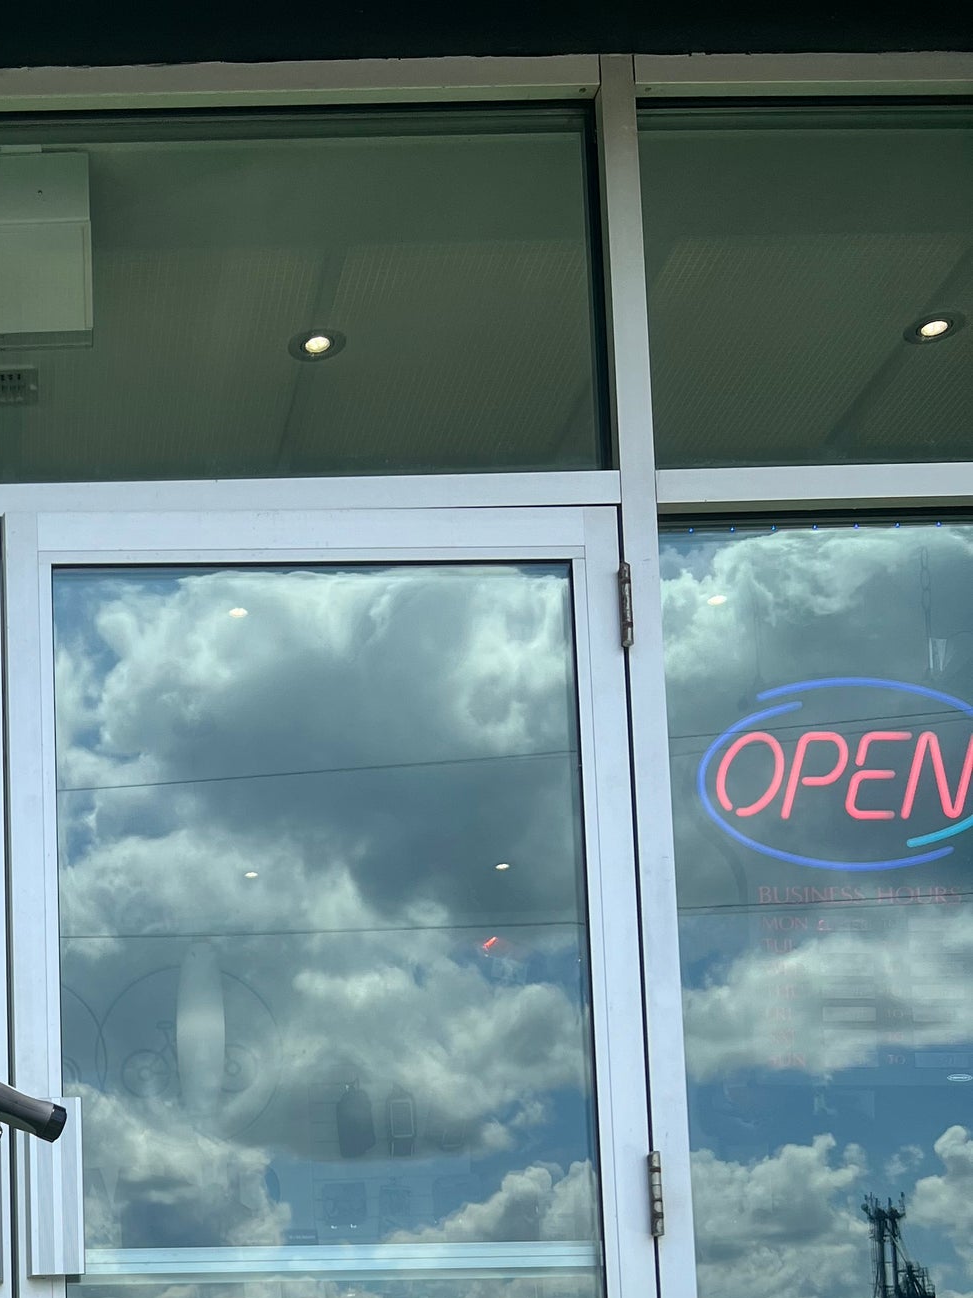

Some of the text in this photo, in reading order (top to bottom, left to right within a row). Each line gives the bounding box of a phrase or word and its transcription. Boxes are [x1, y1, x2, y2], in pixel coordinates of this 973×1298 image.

[716, 731, 973, 820] OPEN
[757, 886, 962, 906] BUSINESS HOURS
